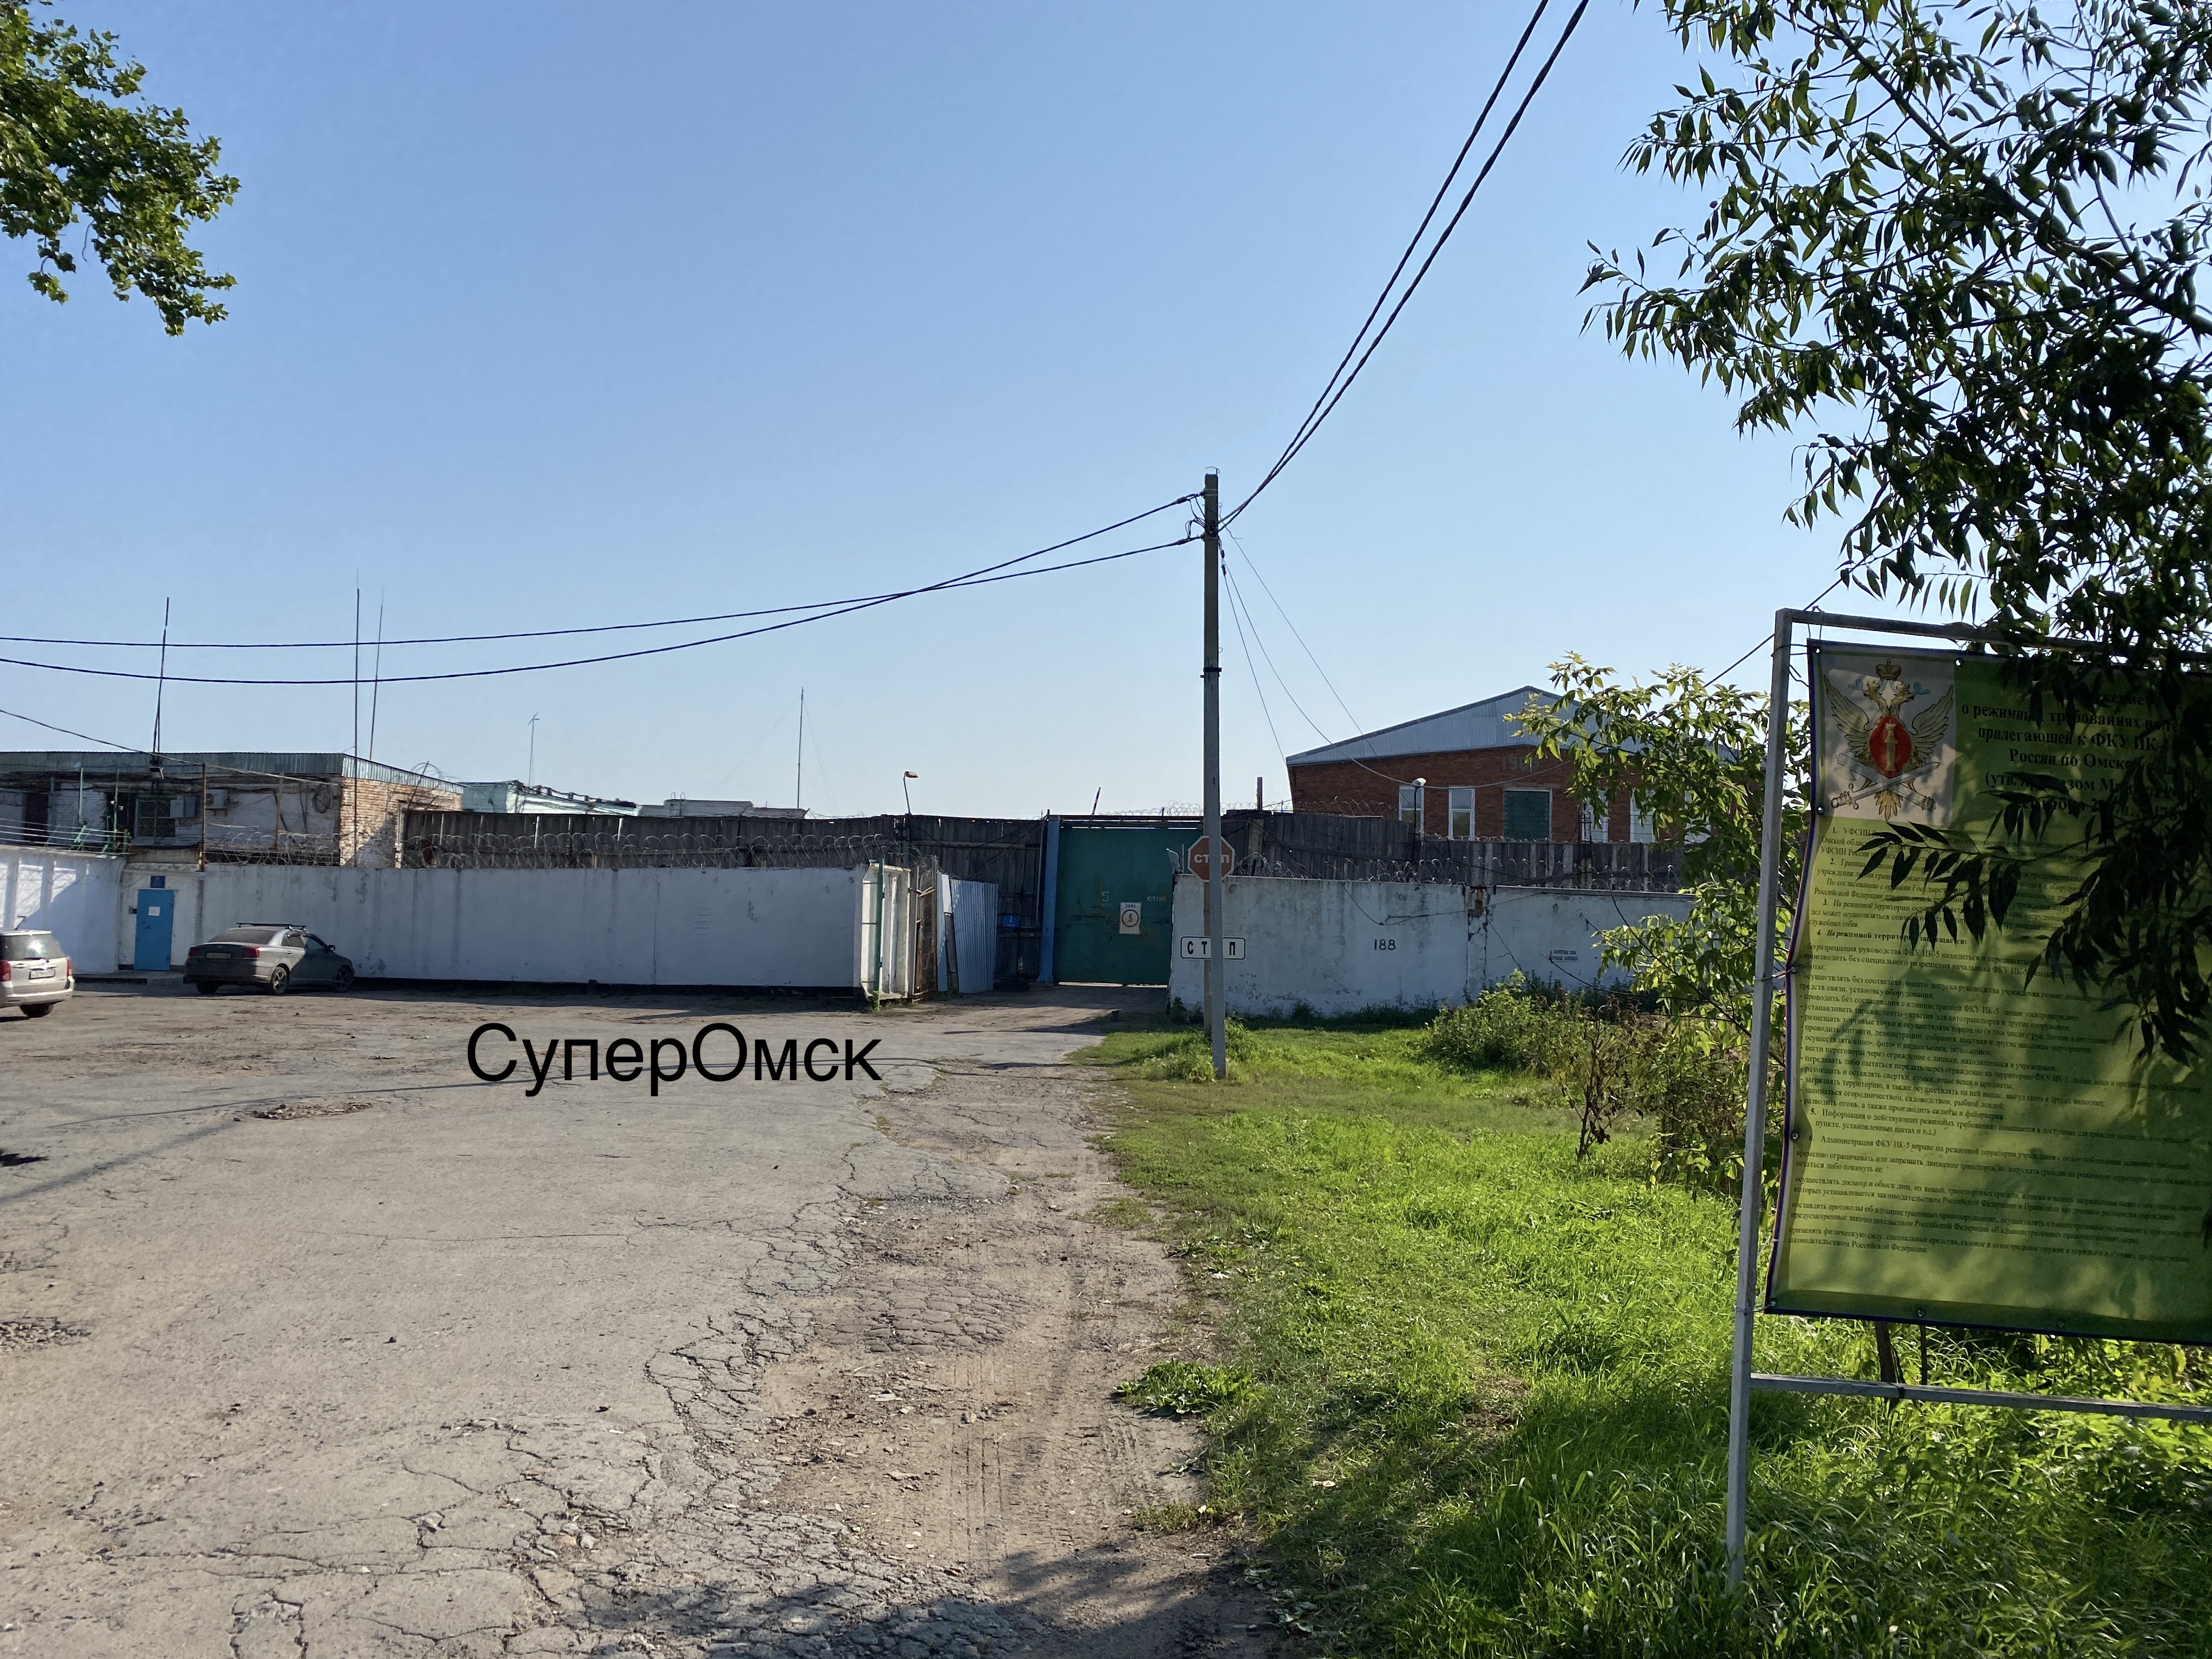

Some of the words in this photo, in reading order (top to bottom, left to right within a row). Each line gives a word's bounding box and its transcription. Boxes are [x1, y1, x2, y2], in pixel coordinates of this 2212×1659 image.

[1961, 704, 1969, 714] о
[1974, 706, 2043, 722] режимны
[2050, 712, 2140, 729] трбованиях
[1978, 727, 2073, 745] прилегающей
[2077, 736, 2086, 746] к
[2091, 733, 2128, 748] ФКУ
[2009, 749, 2056, 765] России
[2061, 755, 2078, 766] по
[1985, 771, 2017, 788] (утв.
[1821, 837, 1846, 845] Омской
[1193, 854, 1230, 864] СТП
[1821, 846, 1847, 855] УФСИН
[1817, 868, 1854, 877] учреждения
[1814, 888, 1849, 896] Российской
[1837, 881, 1879, 890] согласованию
[1843, 912, 1890, 921] осуществляться
[1874, 904, 1910, 912] территории
[1128, 913, 1132, 923] 5
[1836, 931, 1872, 940] режимной
[1187, 940, 1236, 956] СТП
[1374, 939, 1396, 951] 188
[1816, 945, 1857, 953] разрешения
[1859, 947, 1901, 955] руководства
[1903, 948, 1919, 956] ФКУ
[1803, 954, 1847, 962] производить
[1861, 958, 1909, 967] специального
[1910, 960, 1951, 970] разрешения
[1952, 964, 1990, 972] начальника
[1803, 974, 1851, 983] осуществлять
[1865, 978, 1928, 989] соответствующего
[1930, 983, 1957, 991] допуска
[1959, 985, 2000, 995] руководства
[2000, 988, 2040, 998] учреждения
[1849, 988, 1883, 996] установку
[1803, 995, 1840, 1003] проводить
[1854, 997, 1900, 1007] согласования
[1906, 1002, 1962, 1012] администрацией
[1963, 1005, 1980, 1013] ФКУ
[1982, 1006, 2000, 1014] ИК-5
[1804, 1005, 1853, 1014] устанавливать
[1883, 1009, 1933, 1020] тенты-укрытия
[1949, 1016, 2000, 1026] автотранспорта
[2007, 1020, 2029, 1029] другие
[1804, 1015, 1841, 1023] размещать
[1843, 1017, 1875, 1025] торговые
[1904, 1023, 1950, 1032] осуществлять
[1951, 1026, 1983, 1035] торговлю
[1805, 1025, 1841, 1033] проводить
[1842, 1027, 1873, 1036] митинги,
[1995, 1041, 2017, 1049] другие
[1805, 1036, 1852, 1045] осуществлять
[1876, 1040, 1895, 1048] фото-
[1825, 1047, 1865, 1057] переговоры
[1886, 1052, 1926, 1061] ограждение
[1961, 1059, 2009, 1068] находящимися
[1804, 1056, 1842, 1065] передавать
[1862, 1061, 1893, 1069] пытаться
[1894, 1063, 1925, 1071] передать
[1926, 1066, 1943, 1074] через
[1945, 1068, 1984, 1077] ограждение
[1994, 1073, 2033, 1081] территорию
[1804, 1067, 1841, 1075] размещать
[1805, 1077, 1841, 1086] загрязнять
[1843, 1080, 1884, 1090] территорию,
[1913, 1087, 1959, 1096] осуществлять
[1805, 1088, 1842, 1096] заниматься
[1954, 1099, 1979, 1107] рыбной
[1803, 1098, 1837, 1107] разводить
[1888, 1105, 1931, 1115] производить
[1822, 1108, 1866, 1119] Информация
[1873, 1114, 1918, 1124] действующих
[1920, 1118, 1955, 1127] режимных
[1956, 1121, 1997, 1131] требованиях
[1842, 1122, 1893, 1132] установленных
[1820, 1135, 1874, 1147] Администрация
[1875, 1139, 1892, 1147] ФКУ
[1894, 1141, 1910, 1149] ИК-5
[1945, 1147, 1979, 1156] режимной
[1981, 1150, 2017, 1159] территории
[1796, 1151, 1829, 1159] временно
[1830, 1153, 1875, 1163] ограничивать
[1889, 1158, 1923, 1166] запрещать
[1926, 1160, 1959, 1169] движение
[2007, 1167, 2040, 1176] допускать
[1843, 1164, 1874, 1173] покинуть
[1795, 1177, 1840, 1186] осуществлять
[1841, 1180, 1867, 1189] досмотр
[1875, 1180, 1895, 1189] обыск
[1948, 1188, 1993, 1198] транспортных
[1794, 1187, 1821, 1195] которых
[1822, 1188, 1875, 1198] устанавливается
[1877, 1192, 1941, 1204] законодательством
[1942, 1196, 1979, 1207] Российской
[1981, 1199, 2017, 1210] Федерации
[1792, 1201, 1827, 1210] составлять
[1829, 1204, 1864, 1213] протоколы
[1875, 1207, 1938, 1218] административных
[1791, 1212, 1847, 1222] предусмотренные
[1849, 1215, 1914, 1227] законодательством
[1915, 1220, 1952, 1230] Российской
[1954, 1223, 1990, 1233] Федерации
[1788, 1238, 1850, 1248] законодательством
[1852, 1240, 1889, 1250] Российской
[1789, 1227, 1822, 1235] применять
[1823, 1228, 1866, 1239] физическую
[1886, 1234, 1928, 1244] специальные
